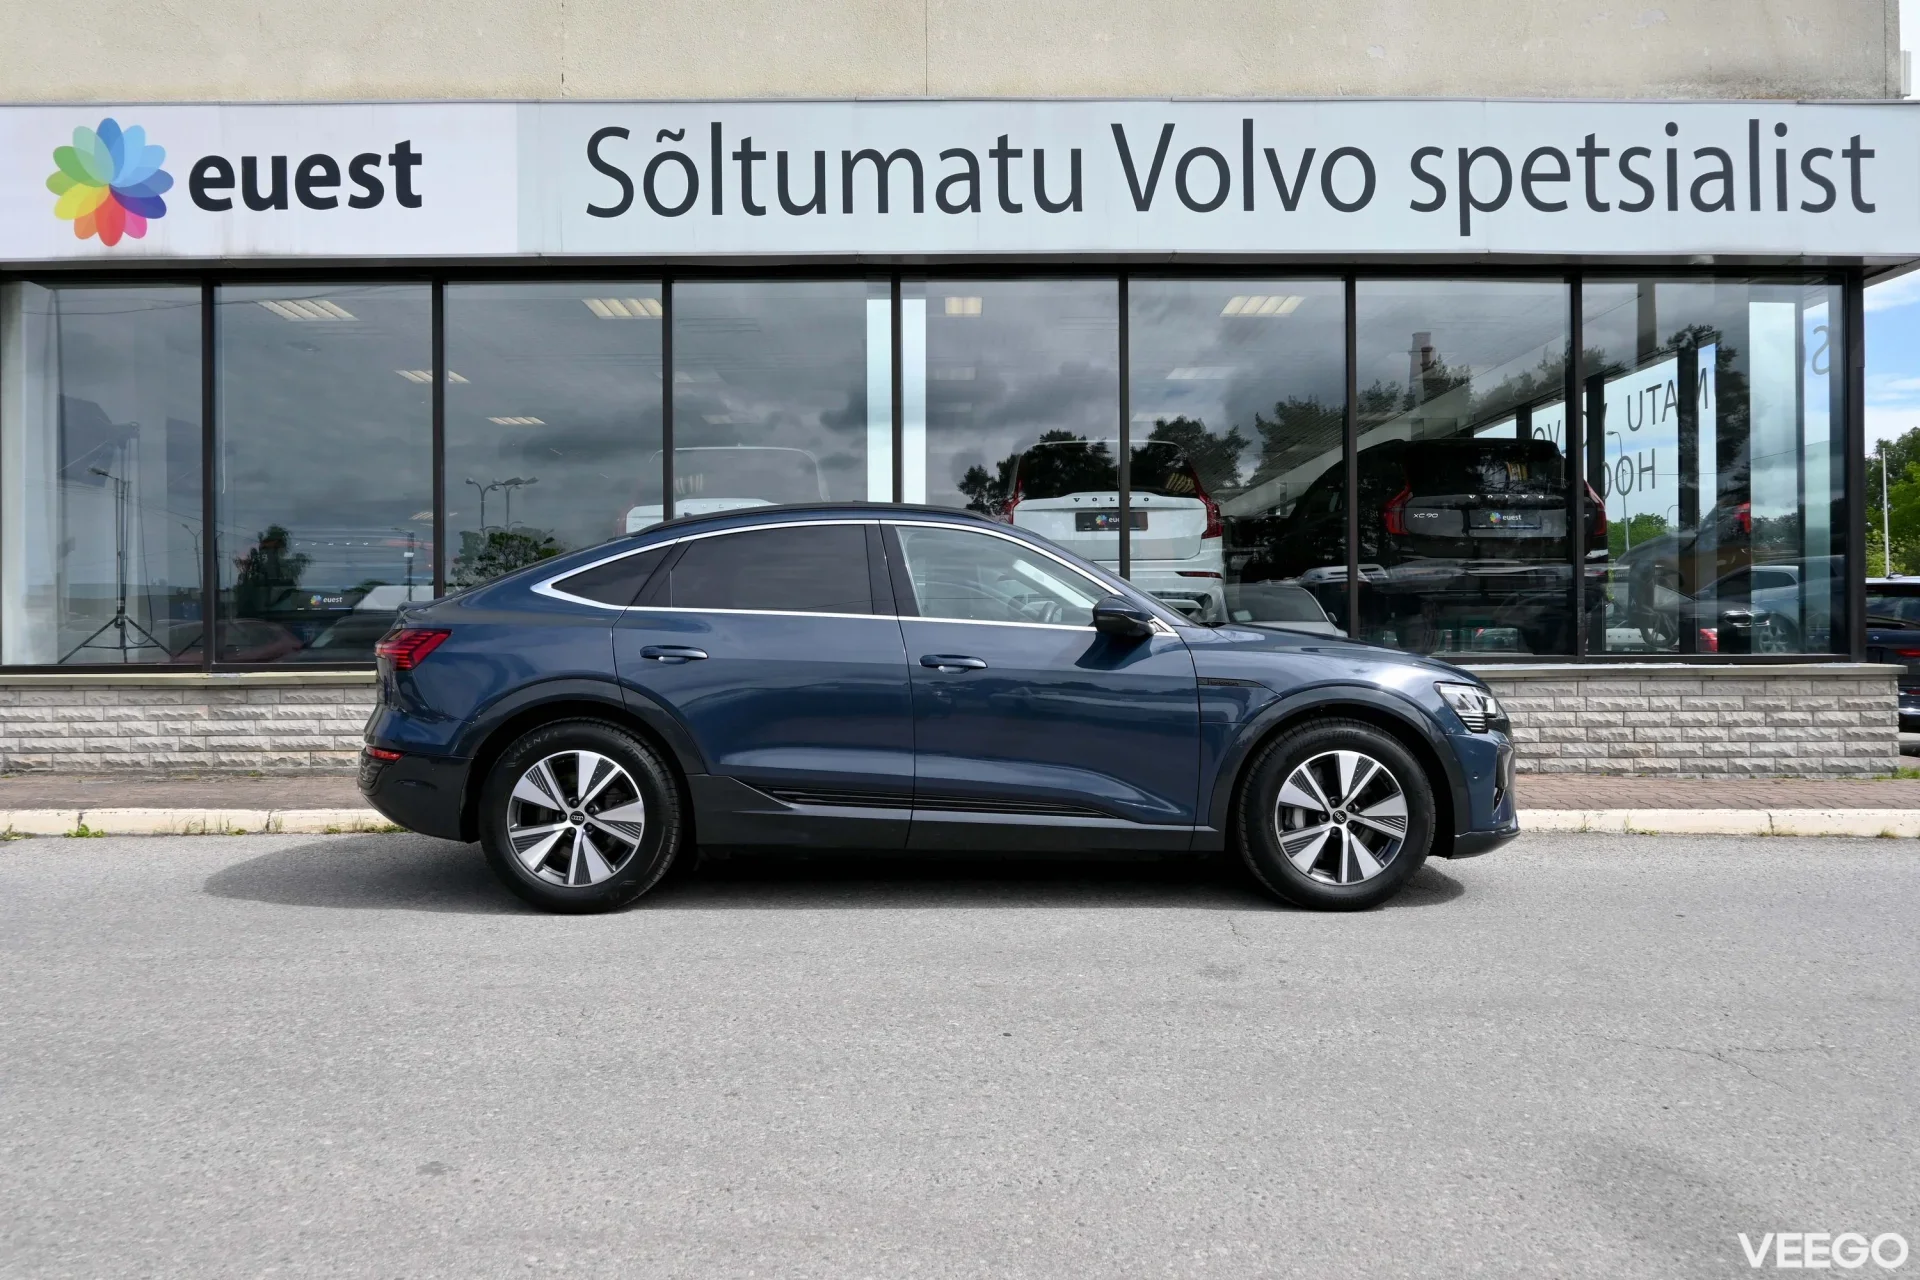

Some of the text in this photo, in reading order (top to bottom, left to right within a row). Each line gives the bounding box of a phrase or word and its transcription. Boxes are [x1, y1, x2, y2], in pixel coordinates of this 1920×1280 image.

[188, 139, 423, 212] euest
[586, 118, 1876, 237] Sõltumatu Volvo spetsialist
